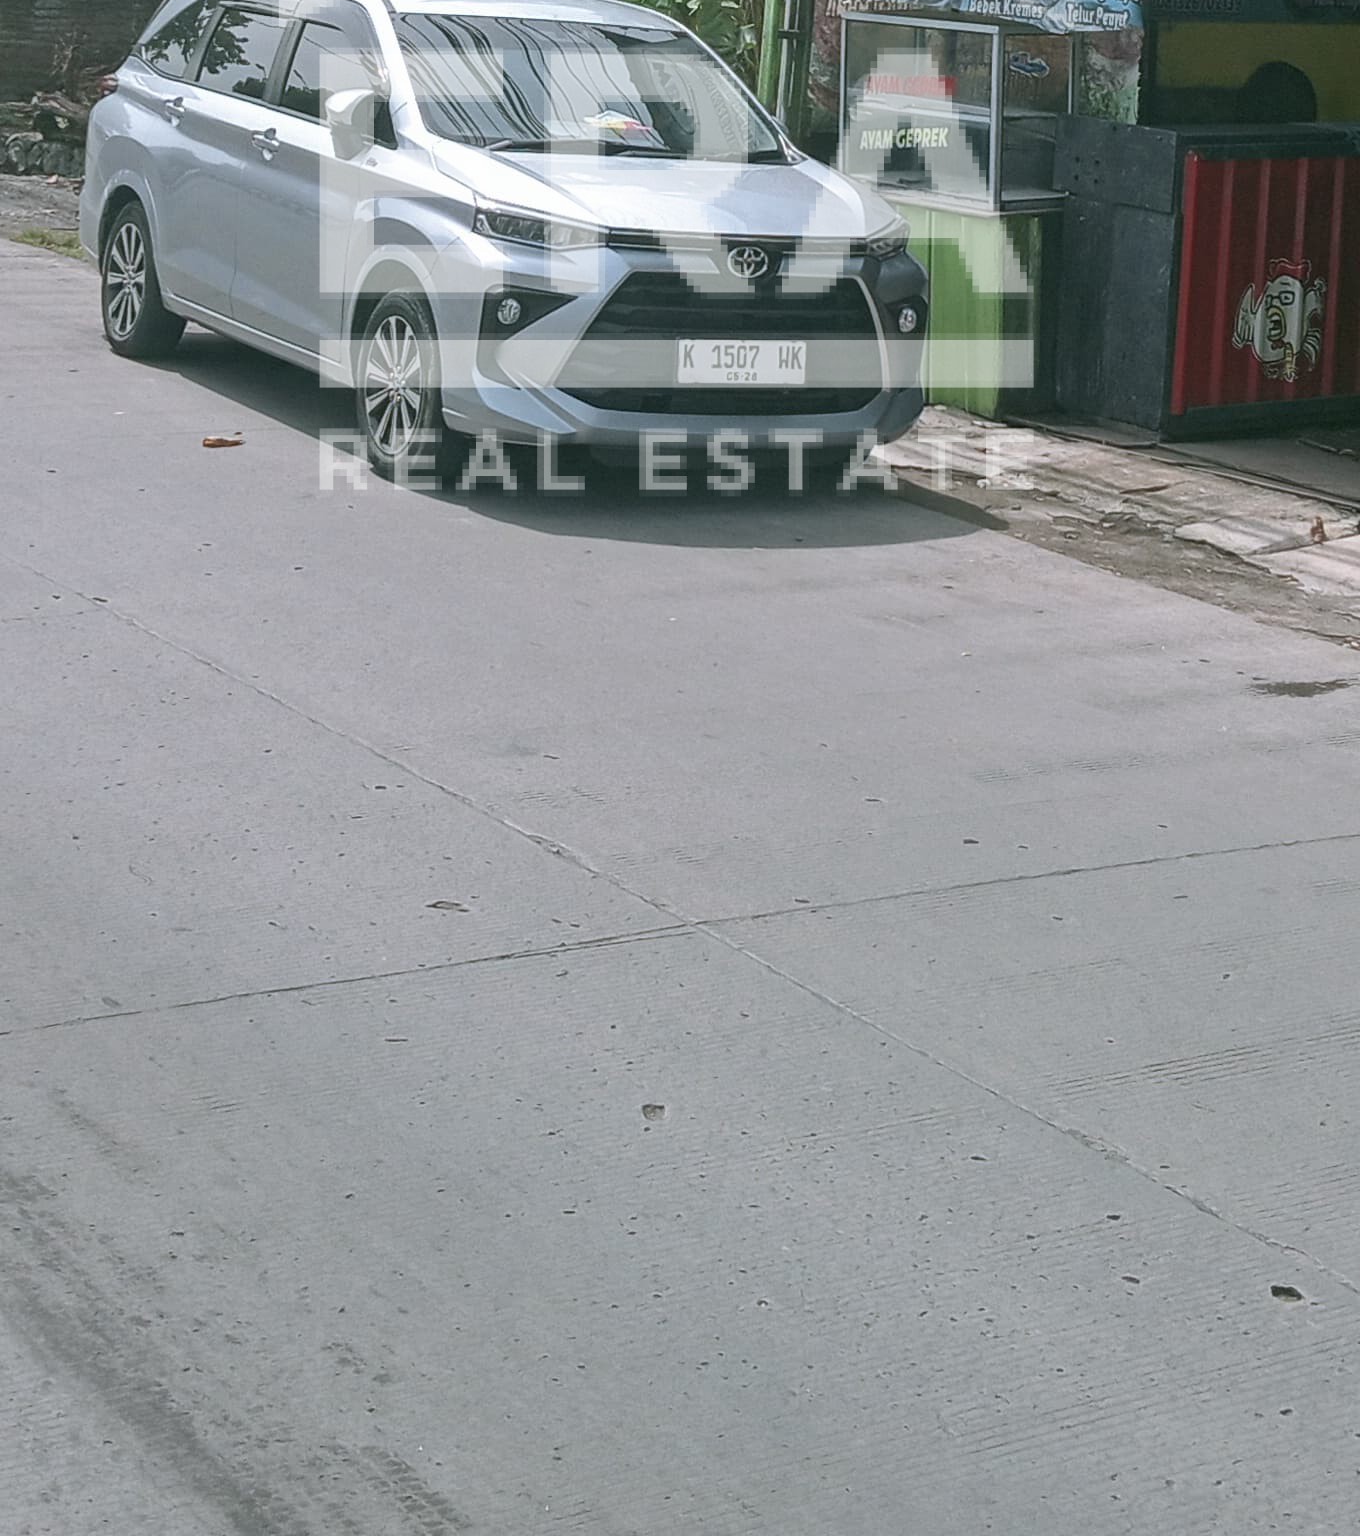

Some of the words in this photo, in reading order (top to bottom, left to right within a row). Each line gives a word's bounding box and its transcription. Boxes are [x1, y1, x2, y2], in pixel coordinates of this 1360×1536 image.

[1066, 3, 1095, 25] Telur
[860, 129, 893, 150] AYAM
[895, 127, 949, 149] GEPREK
[683, 344, 695, 369] K
[711, 345, 760, 369] 1507
[778, 345, 803, 370] WK
